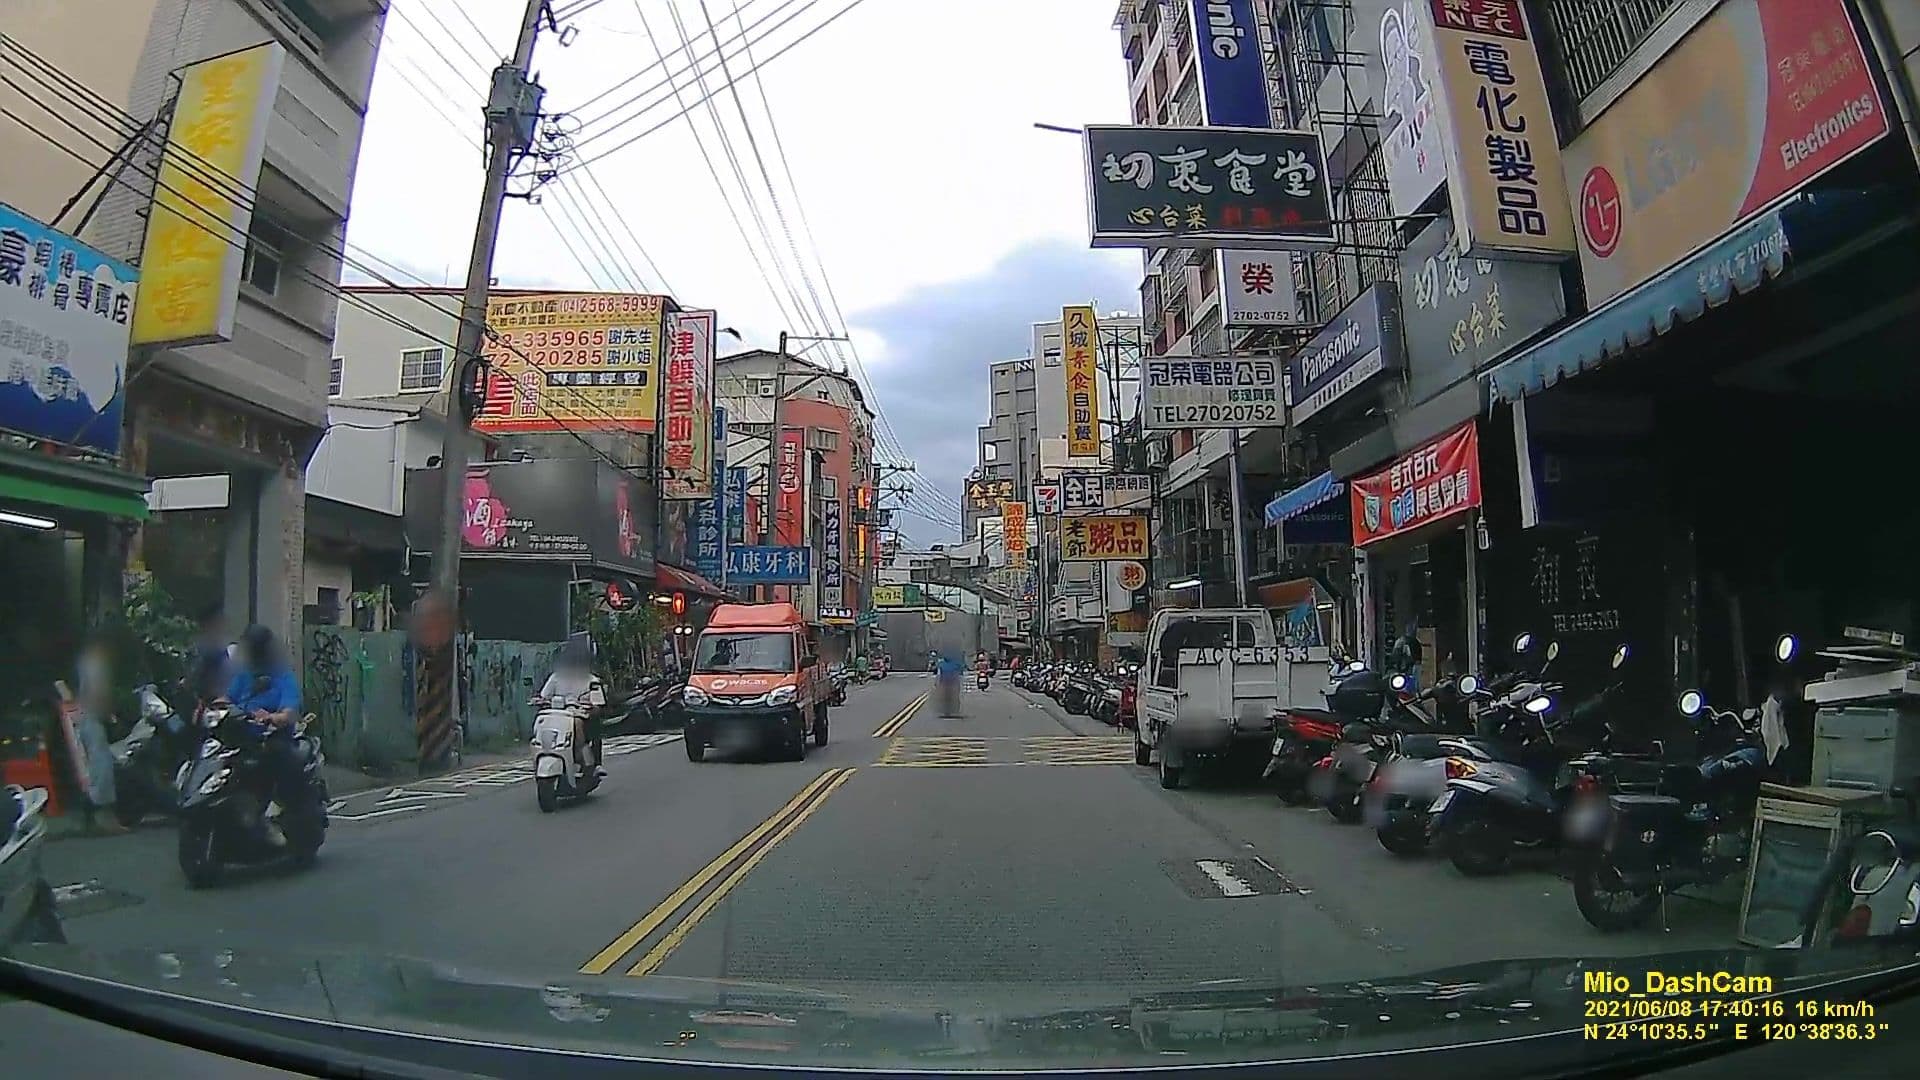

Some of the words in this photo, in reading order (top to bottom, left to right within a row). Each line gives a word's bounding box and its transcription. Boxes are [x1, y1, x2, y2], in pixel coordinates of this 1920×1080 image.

[1445, 10, 1514, 34] NEC
[1464, 39, 1546, 236] 電化製品
[1779, 93, 1875, 171] Electronics
[1101, 146, 1316, 197] 初衷食堂
[1241, 262, 1275, 296] 榮
[1232, 311, 1290, 321] 2702-0752
[1301, 317, 1361, 389] Panasonic
[1149, 361, 1275, 387] 冠榮電器公司
[1065, 478, 1102, 506] 全民
[1089, 520, 1143, 554] 粥品
